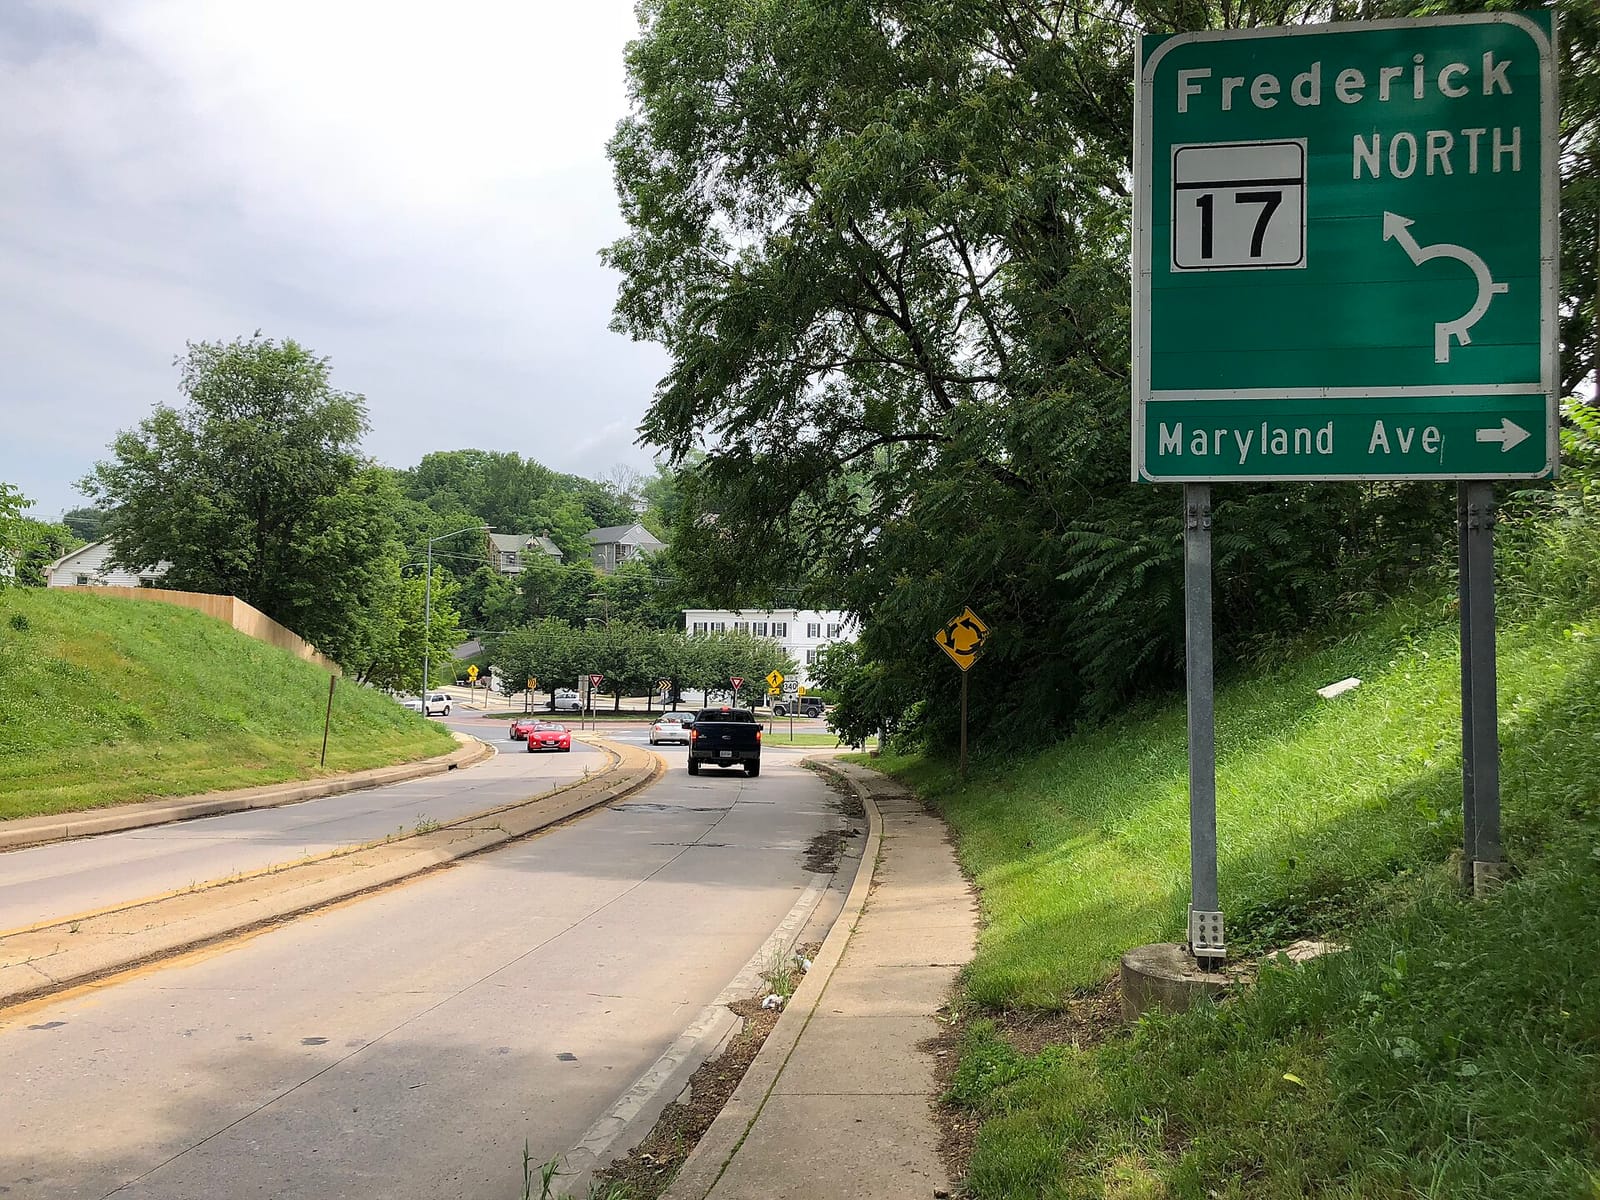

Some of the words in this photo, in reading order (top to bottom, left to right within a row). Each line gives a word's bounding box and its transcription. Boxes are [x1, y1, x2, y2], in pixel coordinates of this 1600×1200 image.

[1177, 51, 1512, 113] Frederick
[1353, 127, 1521, 179] NORTH
[1196, 190, 1283, 260] 17
[1159, 421, 1333, 465] Maryland
[1369, 420, 1441, 454] Ave
